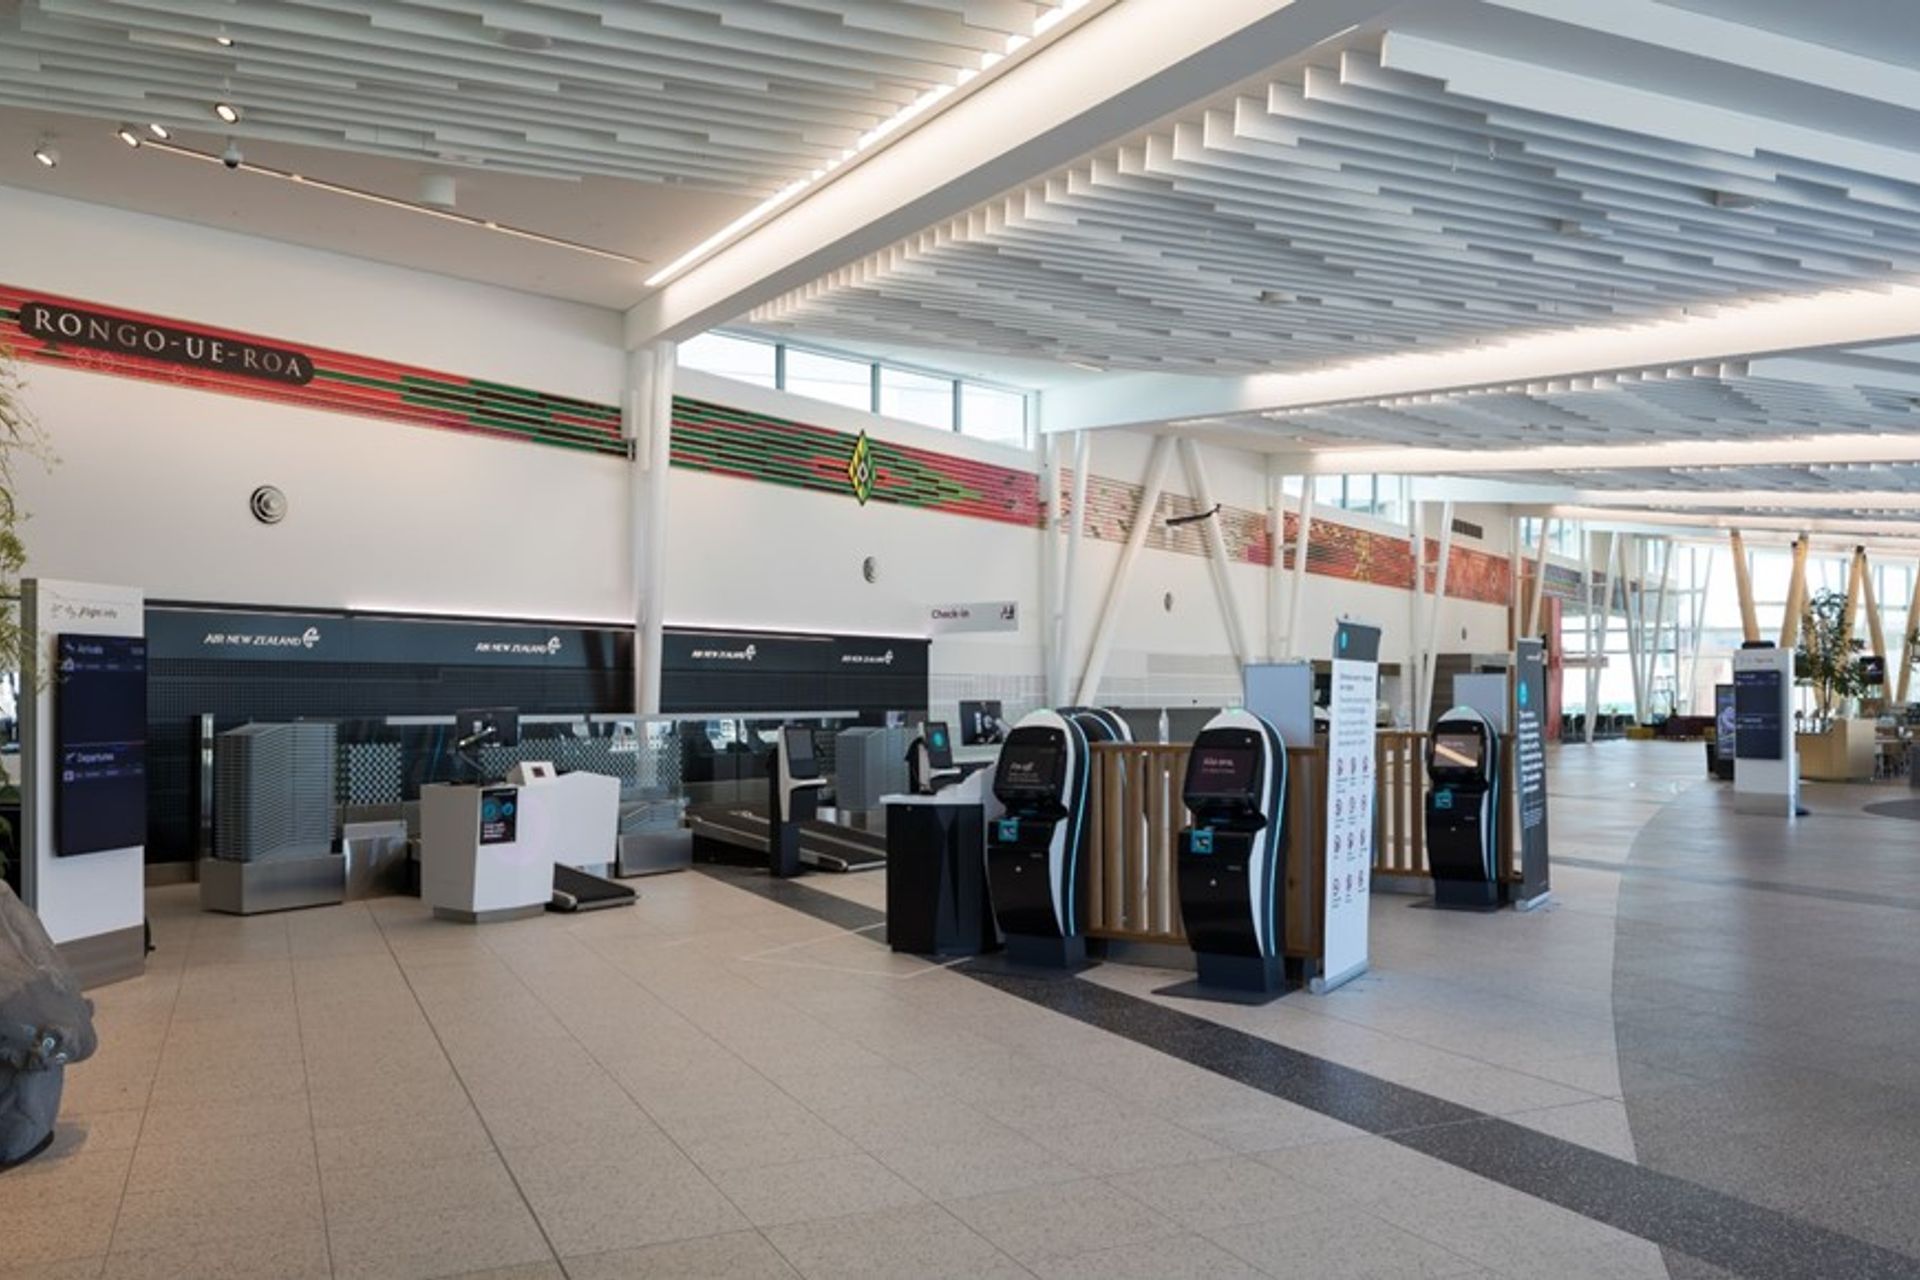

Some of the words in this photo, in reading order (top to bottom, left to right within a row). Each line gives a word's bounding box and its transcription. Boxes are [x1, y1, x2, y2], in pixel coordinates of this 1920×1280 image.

[34, 308, 303, 378] RONGO-UE-ROA
[203, 632, 225, 644] AIR
[226, 633, 253, 645] NEW
[253, 635, 301, 646] ZEALAND
